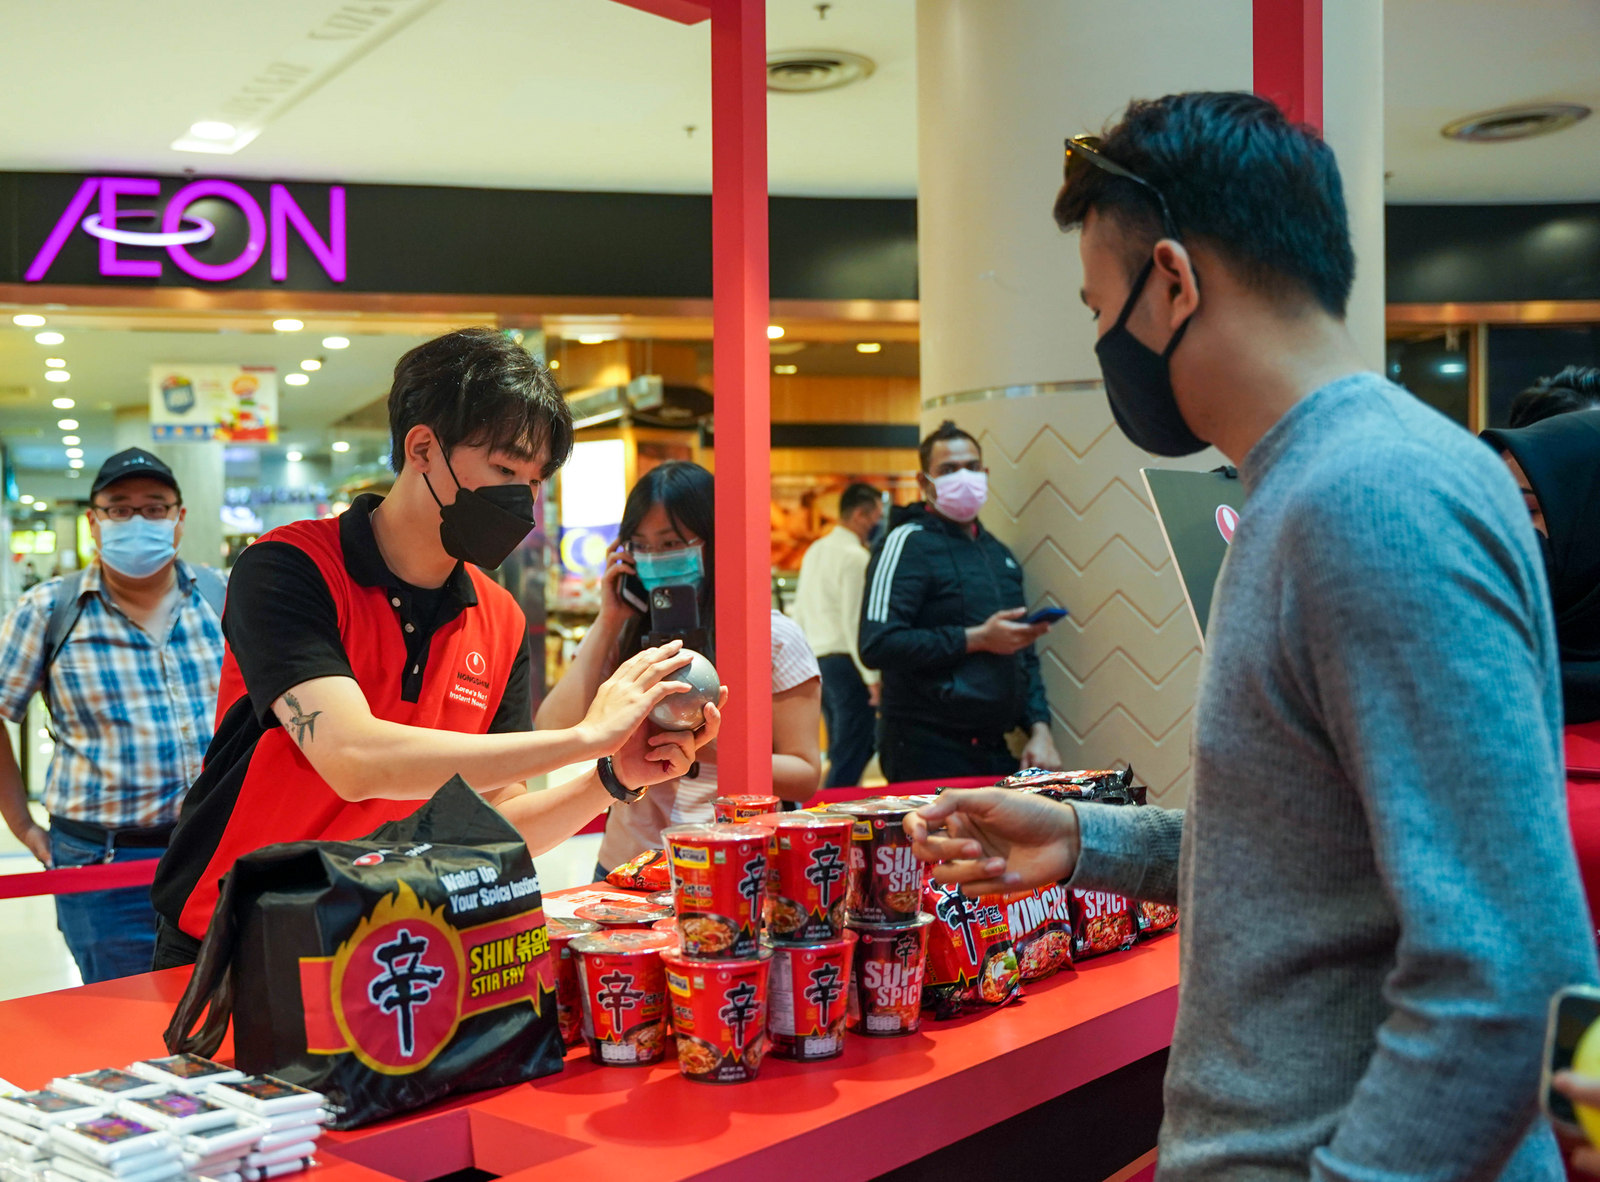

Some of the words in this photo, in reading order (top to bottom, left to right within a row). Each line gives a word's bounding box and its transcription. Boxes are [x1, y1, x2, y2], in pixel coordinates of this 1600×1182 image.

[440, 870, 480, 893] Wake
[478, 866, 498, 884] Up
[450, 891, 479, 914] Your
[480, 883, 512, 907] Spicy
[804, 841, 847, 908] 辛
[976, 904, 1003, 928] 라면
[1007, 885, 1070, 943] KIMCHI
[470, 936, 514, 975] SHIN
[896, 935, 918, 969] 辛
[368, 928, 445, 1057] 辛
[471, 972, 500, 997] STIR
[502, 963, 526, 988] FRY
[597, 969, 645, 1034] 辛
[803, 962, 847, 1027] 辛
[718, 981, 762, 1049] 辛
